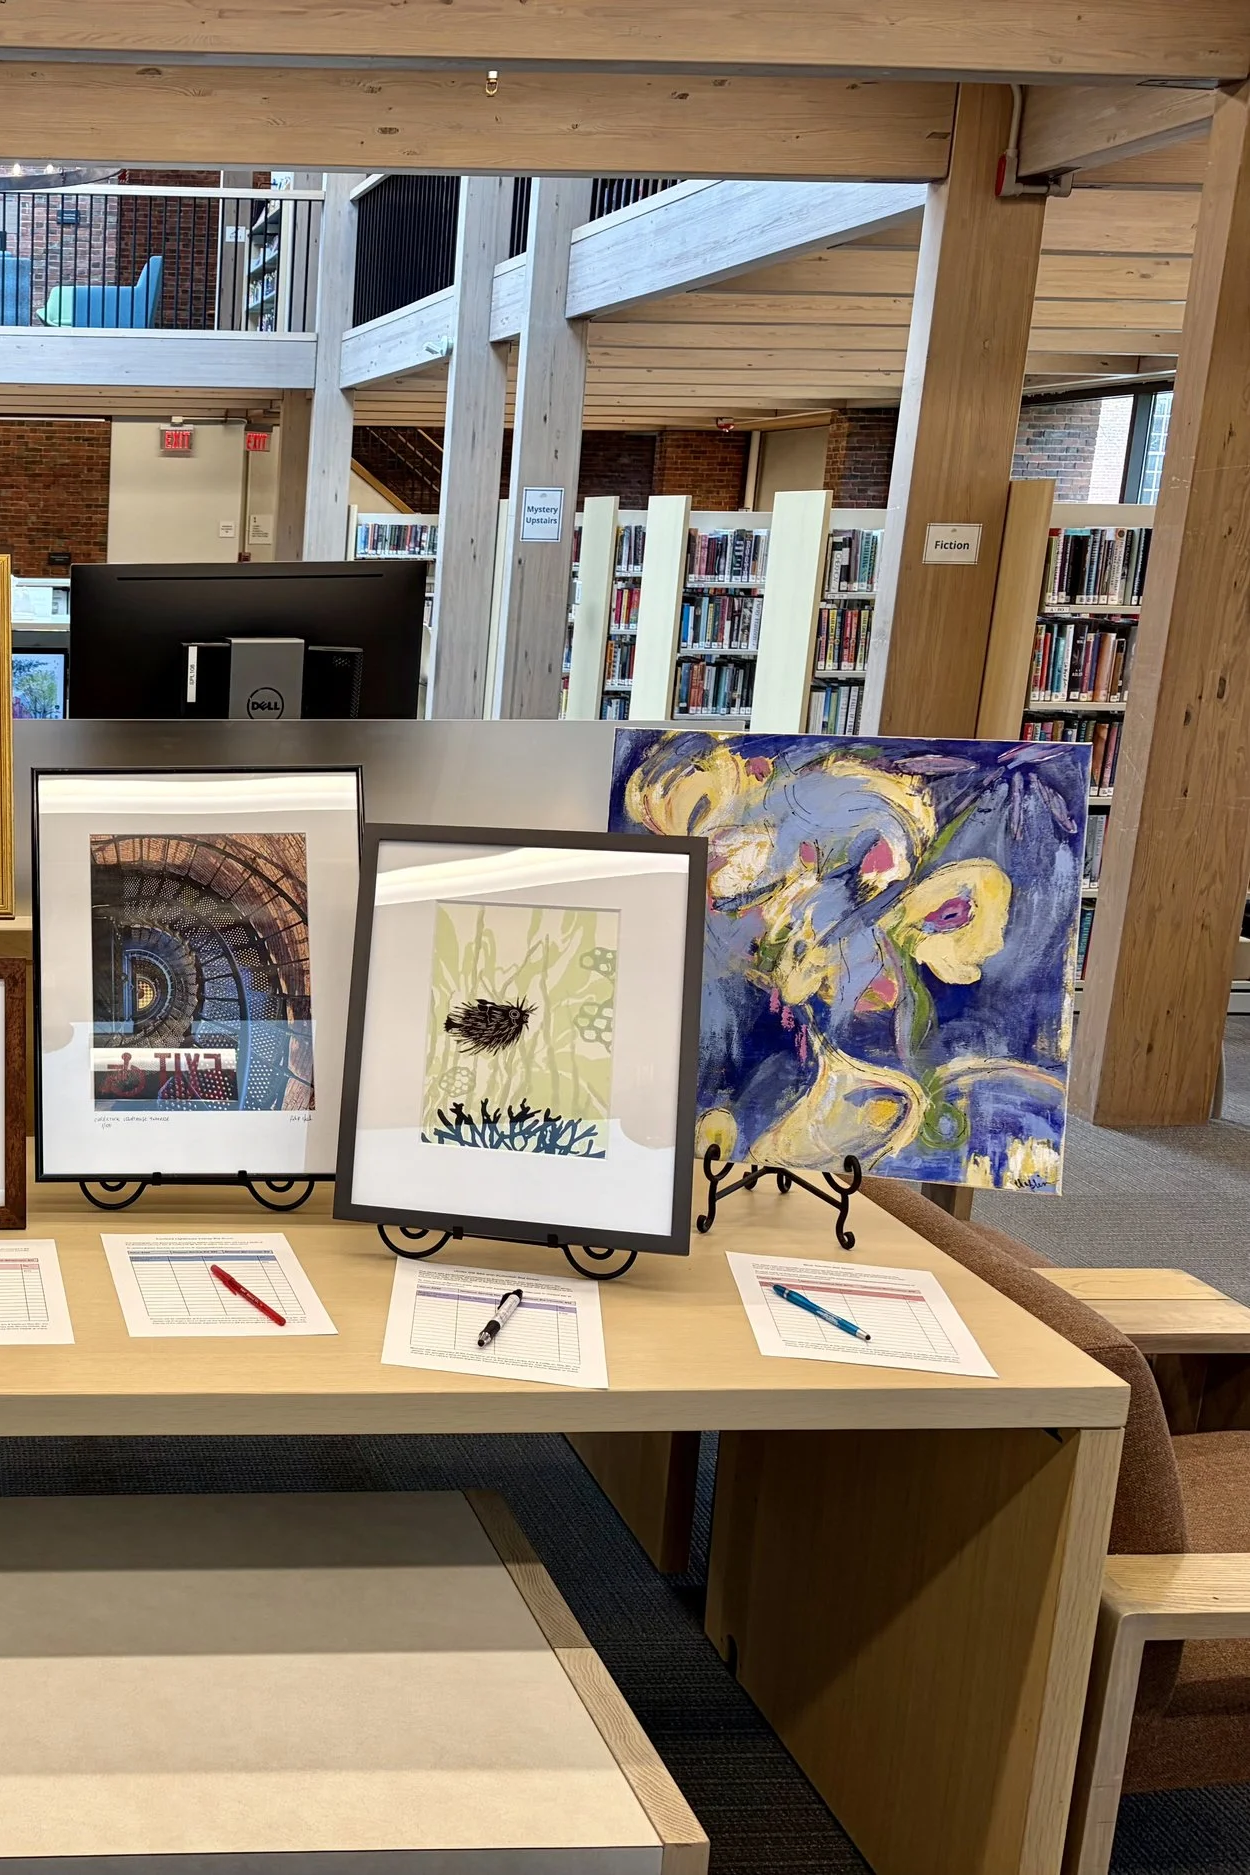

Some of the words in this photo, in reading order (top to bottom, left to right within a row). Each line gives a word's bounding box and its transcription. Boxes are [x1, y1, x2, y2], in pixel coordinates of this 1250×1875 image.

[164, 430, 191, 449] EXIT
[246, 432, 269, 451] EXIT
[526, 506, 558, 515] Mystery
[525, 517, 558, 525] Upstairs
[934, 540, 970, 550] Fiction
[251, 701, 281, 711] DELL
